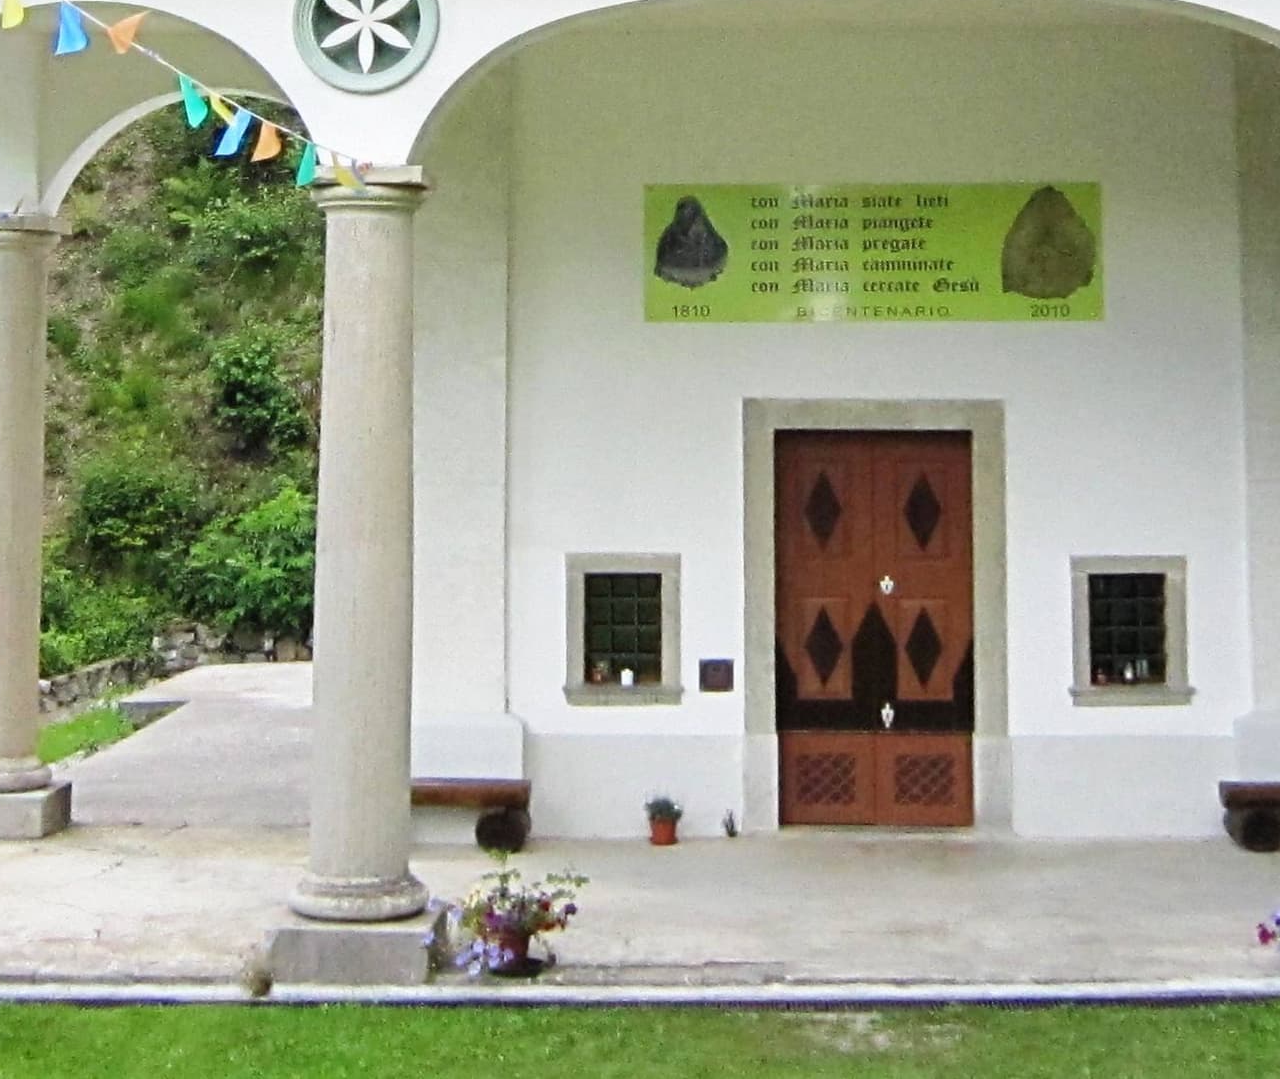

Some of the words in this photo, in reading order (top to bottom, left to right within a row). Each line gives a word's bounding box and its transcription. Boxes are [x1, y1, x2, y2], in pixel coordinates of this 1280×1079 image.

[750, 195, 779, 209] con
[791, 193, 849, 209] Maria
[861, 194, 903, 209] siate
[916, 194, 949, 209] lieti
[750, 217, 779, 230] con
[791, 214, 849, 231] Maria
[861, 215, 934, 233] piangete
[750, 239, 779, 251] con
[791, 235, 849, 252] Maria
[862, 237, 926, 253] pregate
[750, 259, 779, 272] con
[791, 257, 849, 273] Maria
[863, 258, 955, 273] camminate
[750, 280, 779, 293] con
[791, 278, 849, 294] Maria
[863, 279, 920, 293] cercate
[671, 305, 711, 318] 1810
[796, 305, 951, 318] BICENTENARIO
[1030, 304, 1071, 318] 2010
